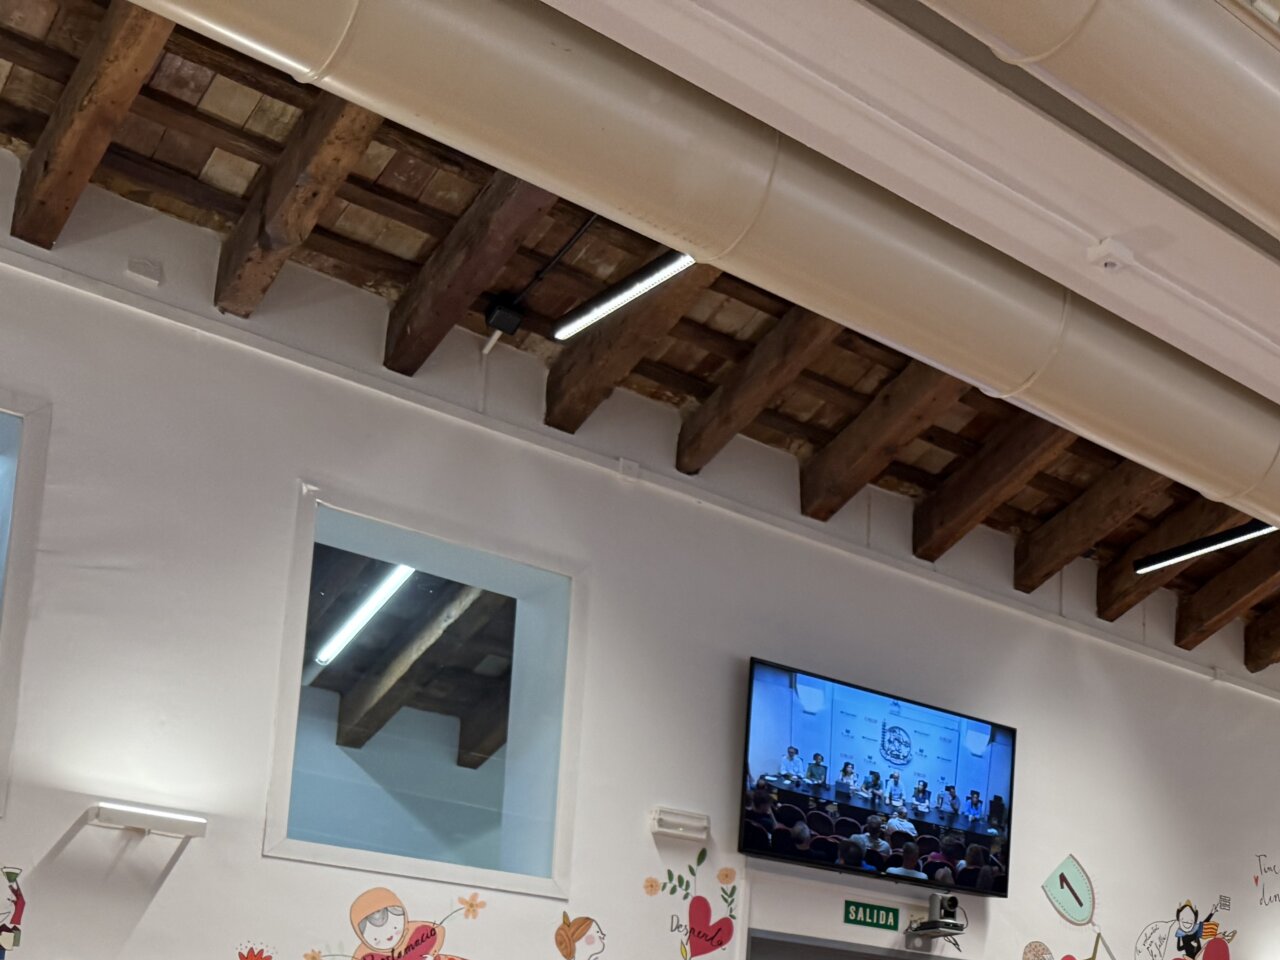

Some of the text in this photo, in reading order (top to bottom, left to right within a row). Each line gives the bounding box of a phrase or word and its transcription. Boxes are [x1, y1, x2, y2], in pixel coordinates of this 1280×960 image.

[1255, 854, 1279, 876] Tinc
[1058, 872, 1084, 908] 1
[848, 905, 895, 926] SALIDA
